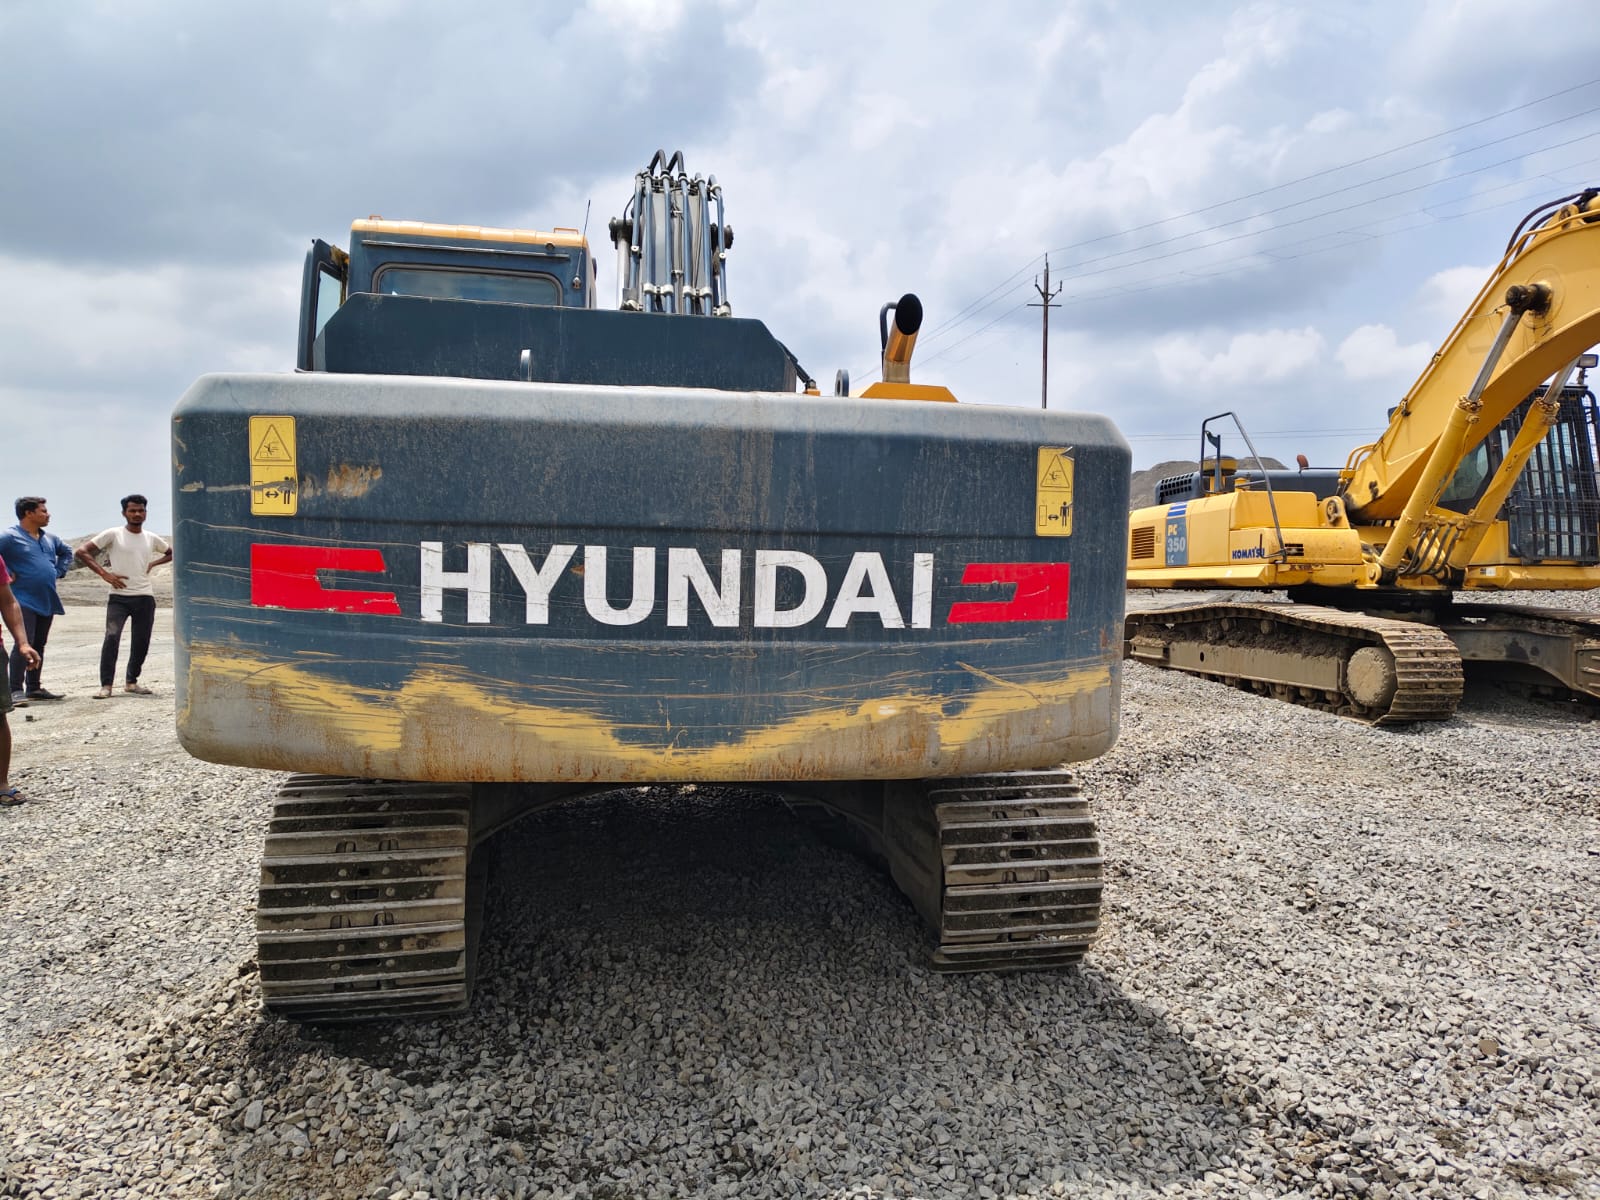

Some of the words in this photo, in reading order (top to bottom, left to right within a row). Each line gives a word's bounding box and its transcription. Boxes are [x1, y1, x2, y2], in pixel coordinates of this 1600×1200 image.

[1167, 525, 1177, 536] PC
[1167, 537, 1185, 552] 350
[1232, 547, 1265, 559] KOMATSU
[420, 540, 934, 629] HYUNDAI
